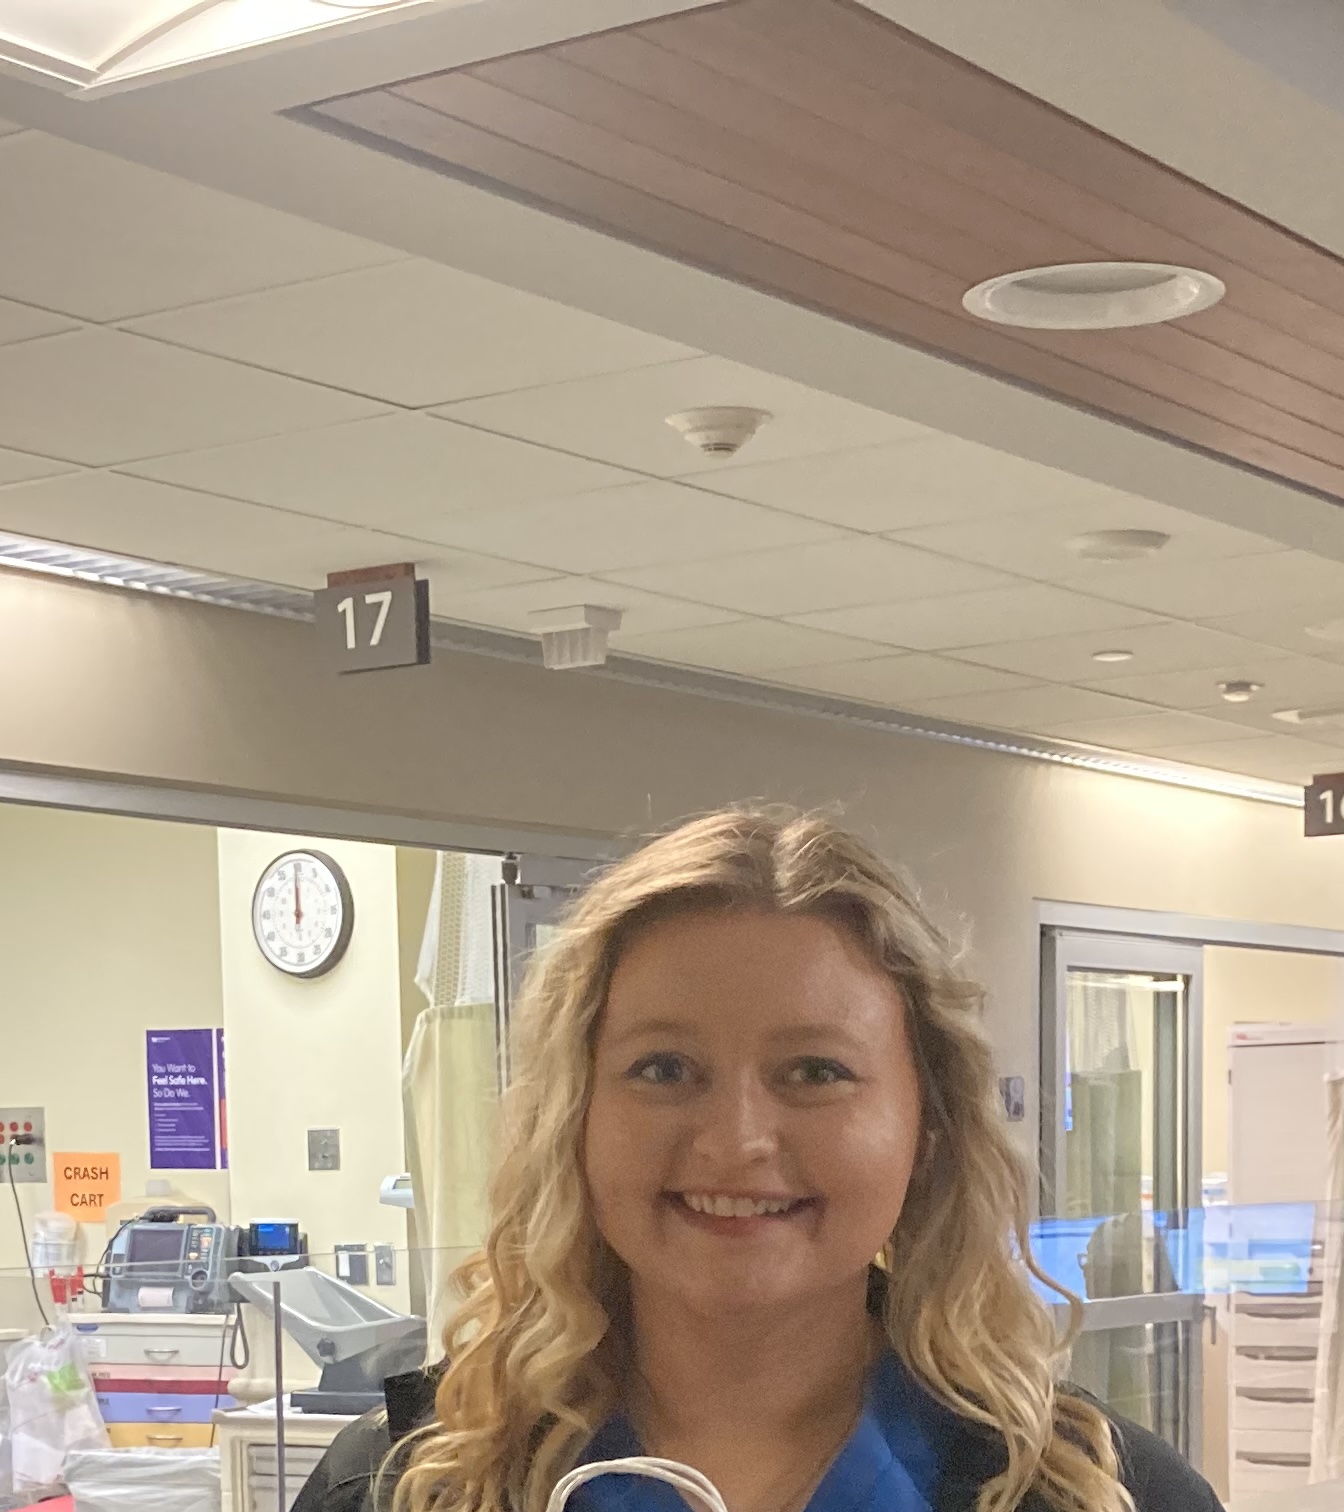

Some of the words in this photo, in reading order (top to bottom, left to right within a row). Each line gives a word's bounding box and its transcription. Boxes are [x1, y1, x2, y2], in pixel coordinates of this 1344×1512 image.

[337, 591, 392, 649] 17
[152, 1075, 168, 1086] Feel
[169, 1075, 186, 1085] Safe
[63, 1166, 109, 1180] CRASH
[70, 1193, 104, 1207] CART
